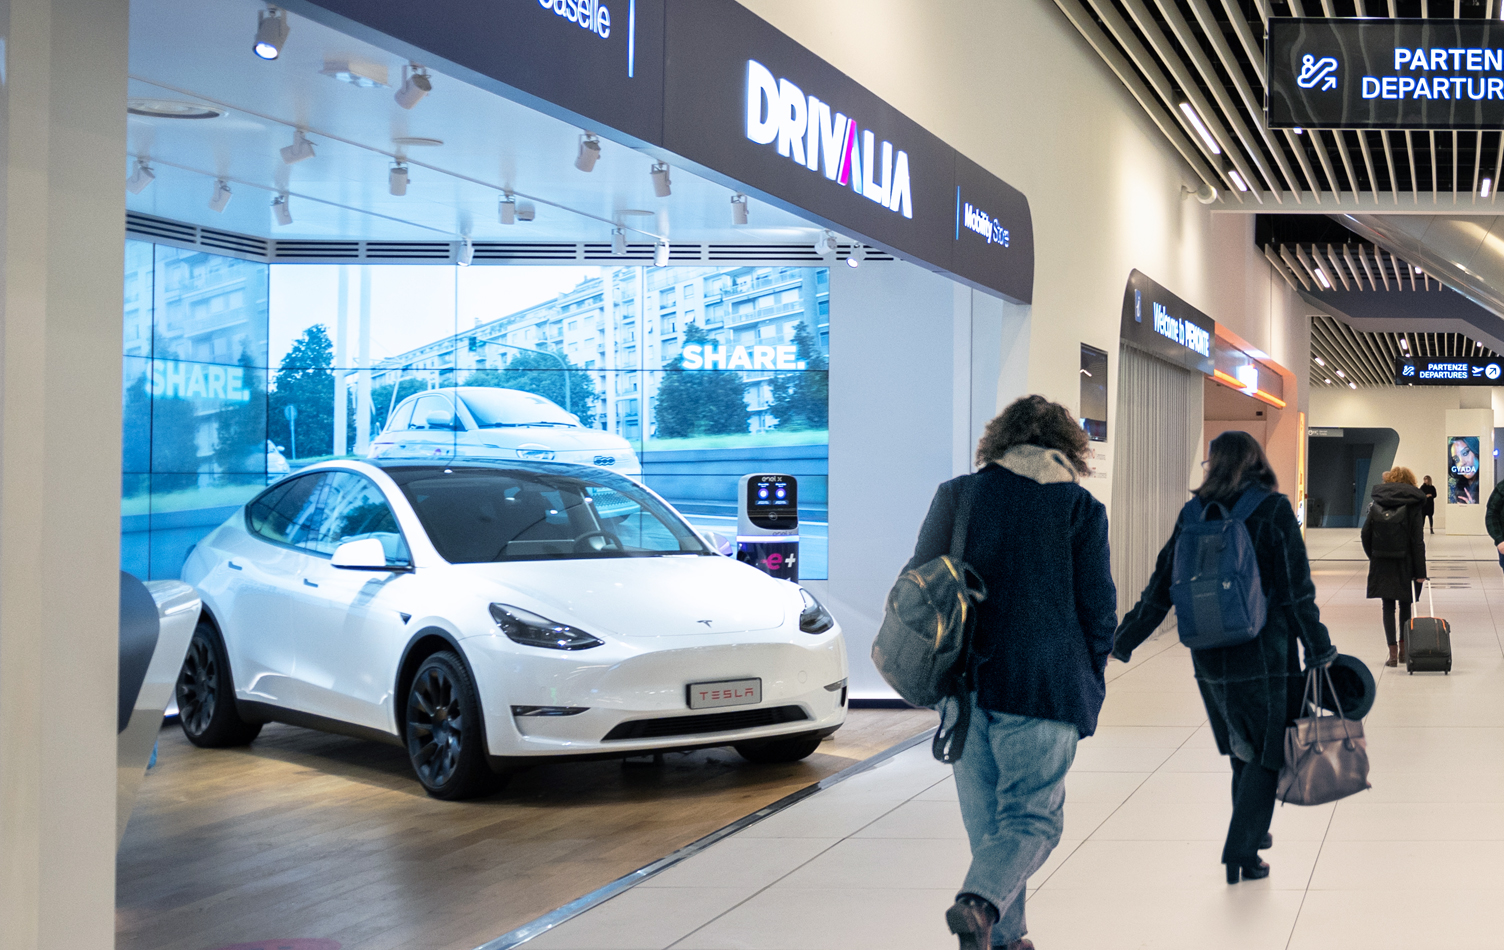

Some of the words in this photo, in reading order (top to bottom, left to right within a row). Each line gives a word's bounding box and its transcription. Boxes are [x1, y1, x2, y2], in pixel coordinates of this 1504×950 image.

[538, 0, 610, 39] aselle
[746, 59, 912, 219] DRIVALIA
[964, 202, 993, 243] Mobility
[1153, 302, 1179, 342] Welcome
[1178, 318, 1185, 346] to
[1185, 320, 1210, 357] PIEMONTE
[681, 344, 806, 370] SHARE.
[1419, 371, 1468, 379] DEPARTURES
[1428, 363, 1468, 371] PARTENZE
[145, 360, 250, 401] SHARE.
[699, 687, 754, 701] TESLA
